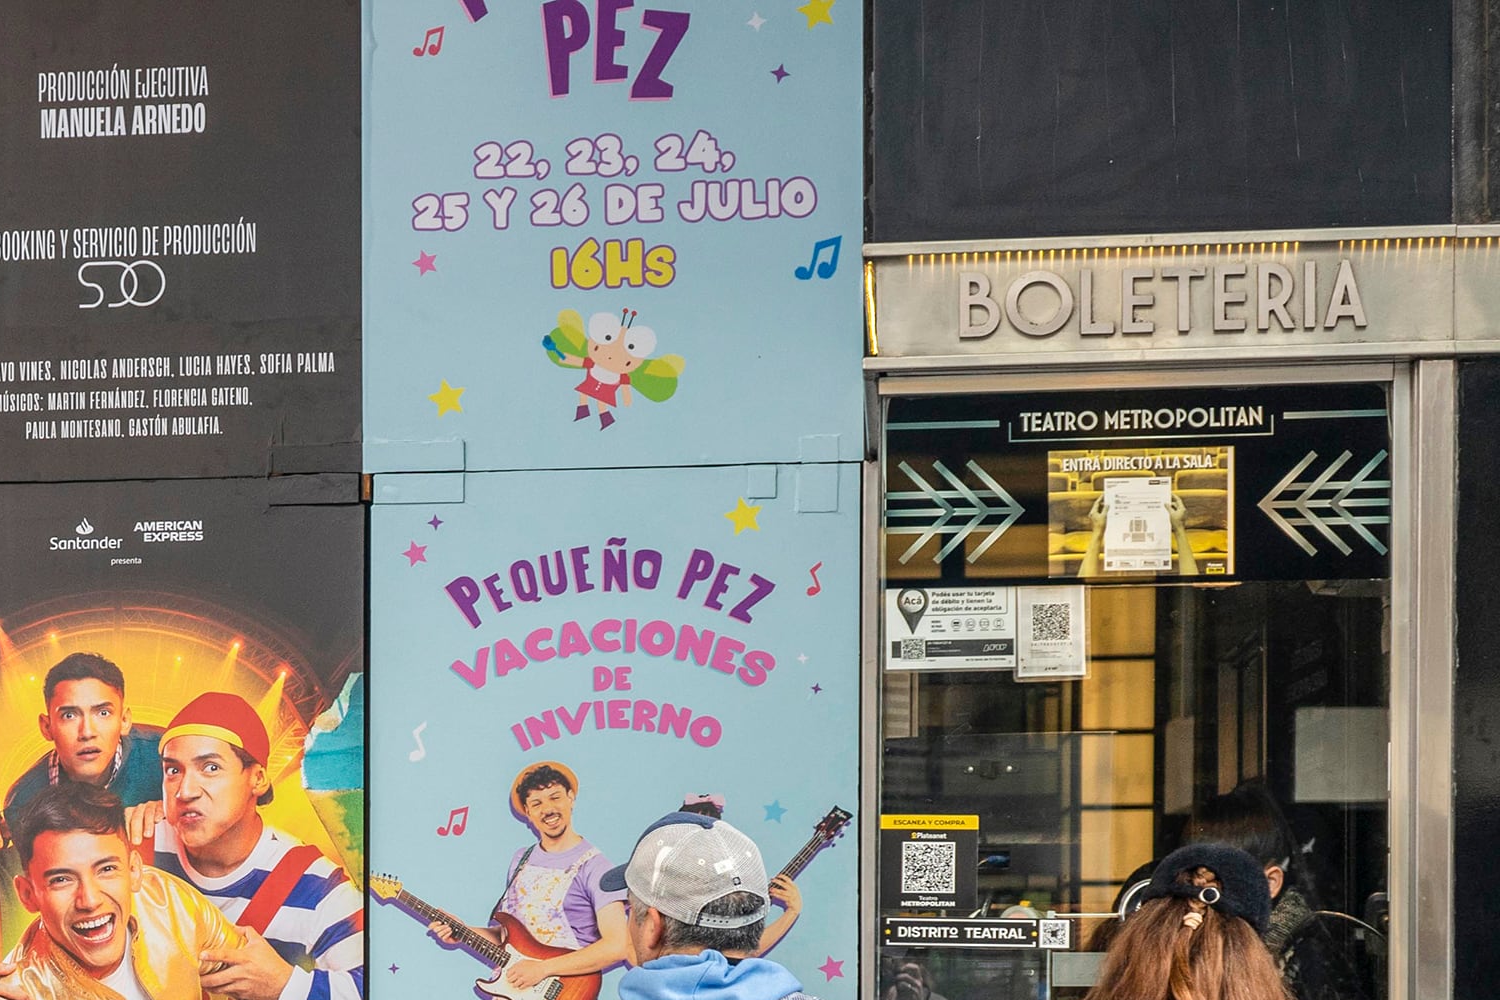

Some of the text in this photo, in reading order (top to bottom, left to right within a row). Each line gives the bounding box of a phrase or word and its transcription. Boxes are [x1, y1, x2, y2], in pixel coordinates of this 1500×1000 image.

[541, 0, 691, 100] PEZ
[38, 64, 209, 102] PRODUCCIÓN EJECUTIVA
[40, 102, 206, 139] MANUELA ARNEDO
[474, 129, 735, 179] 22, 23, 24,
[412, 177, 817, 231] 25 Y 26 DE JULIO
[60, 229, 69, 259] Y
[73, 226, 137, 258] SERVICIO
[142, 226, 159, 256] DE
[163, 217, 257, 256] PRODUCCIÓN
[959, 258, 1368, 340] BOLETERIA
[60, 358, 107, 380] NICOLAS
[180, 355, 211, 376] LUCIA
[260, 353, 292, 374] SOFIA
[297, 352, 335, 373] PALMA
[48, 391, 85, 411] MARTIN
[153, 387, 207, 408] FLORENCIA
[26, 414, 223, 440] PAULA GASTÓN ABULAFIA.
[1020, 406, 1264, 433] TEATRO METROPOLITAN
[1062, 454, 1213, 473] ENTRÁ DIRECTO A LA SALA
[133, 520, 202, 532] AMERICAN
[143, 531, 204, 542] EXPRESS
[50, 536, 123, 551] Santander
[111, 557, 142, 566] presenta
[443, 536, 776, 629] PEQUEÑO PEZ
[904, 595, 923, 606] Acá
[450, 618, 776, 690] VACACIONES
[592, 665, 632, 693] DE
[510, 699, 723, 751] INVIERNO
[964, 926, 1026, 940] TEATRAL
